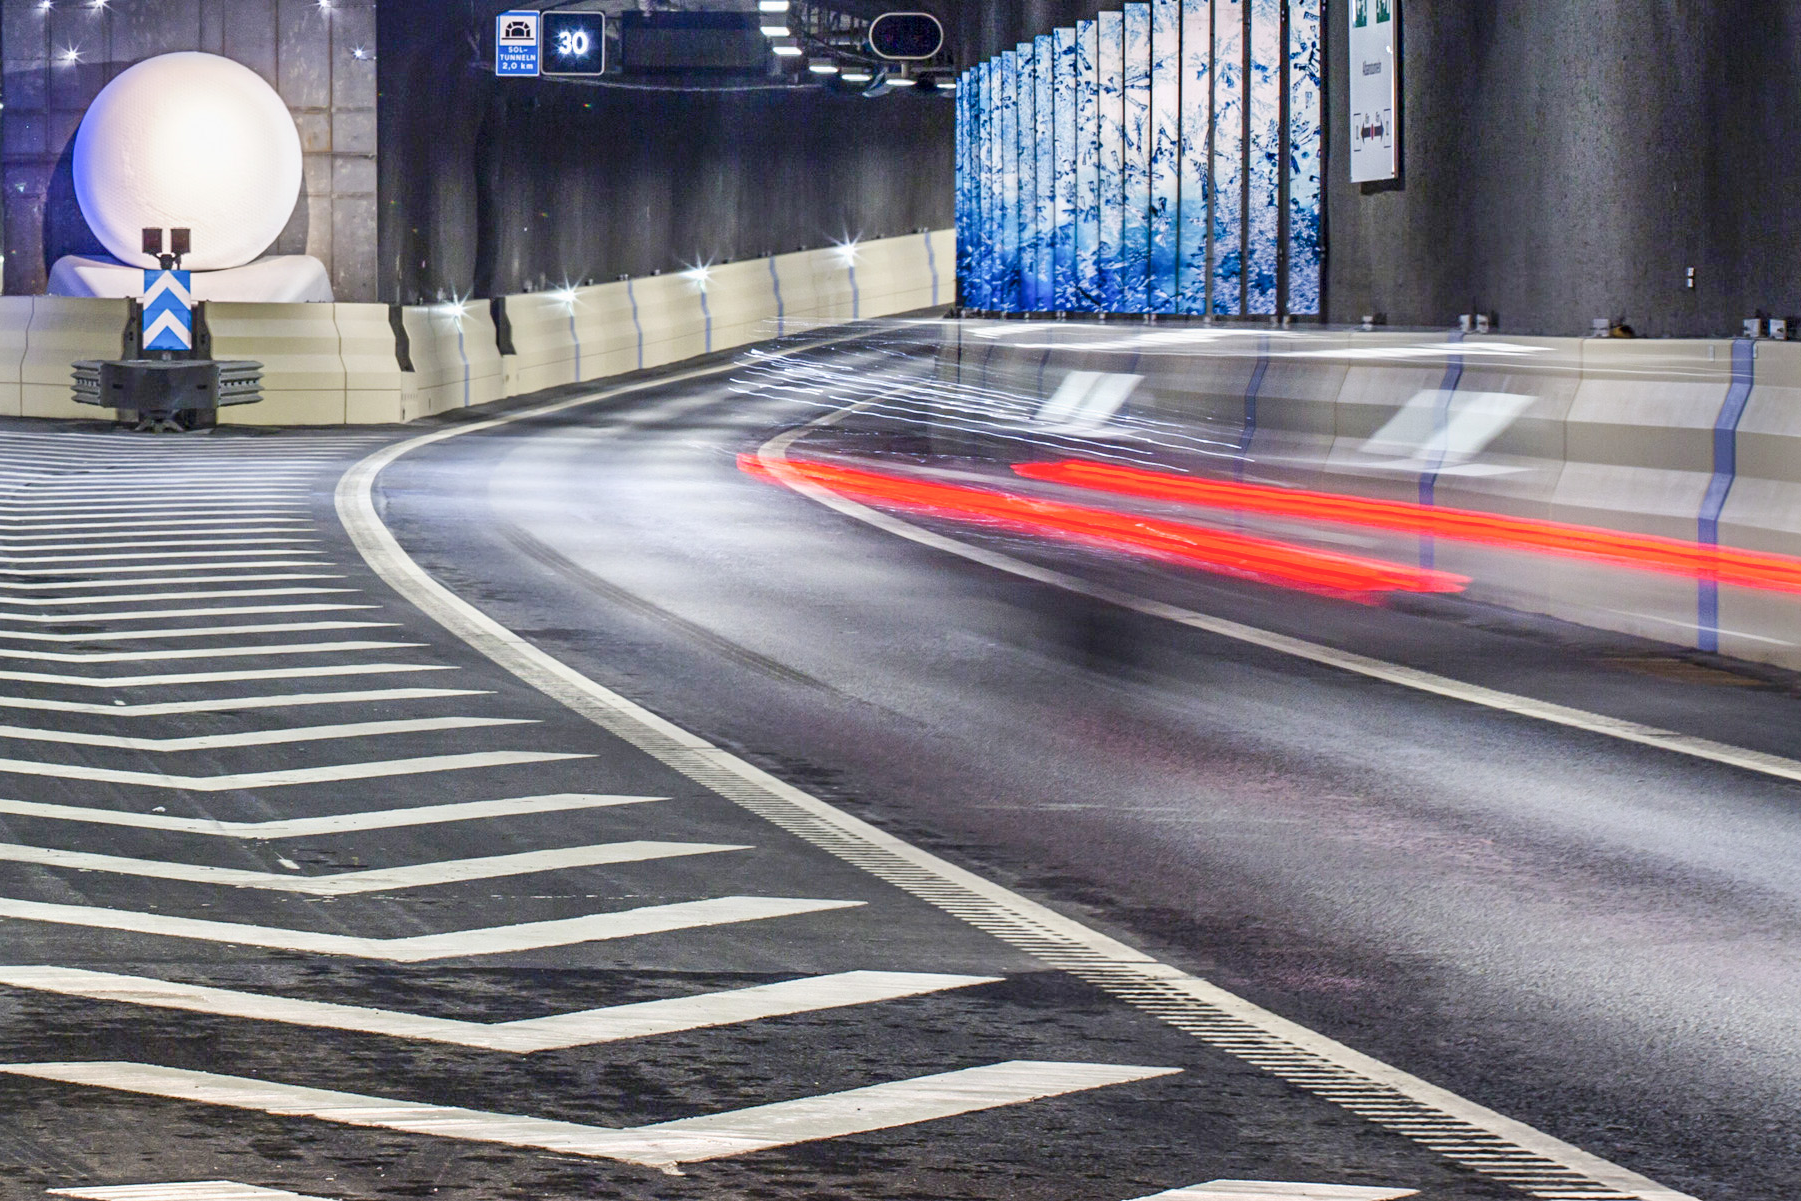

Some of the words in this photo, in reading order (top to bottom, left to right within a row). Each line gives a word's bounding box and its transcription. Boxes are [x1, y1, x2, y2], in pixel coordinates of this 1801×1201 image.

[558, 31, 589, 55] 30
[502, 62, 518, 71] 2,0
[520, 62, 534, 70] km
